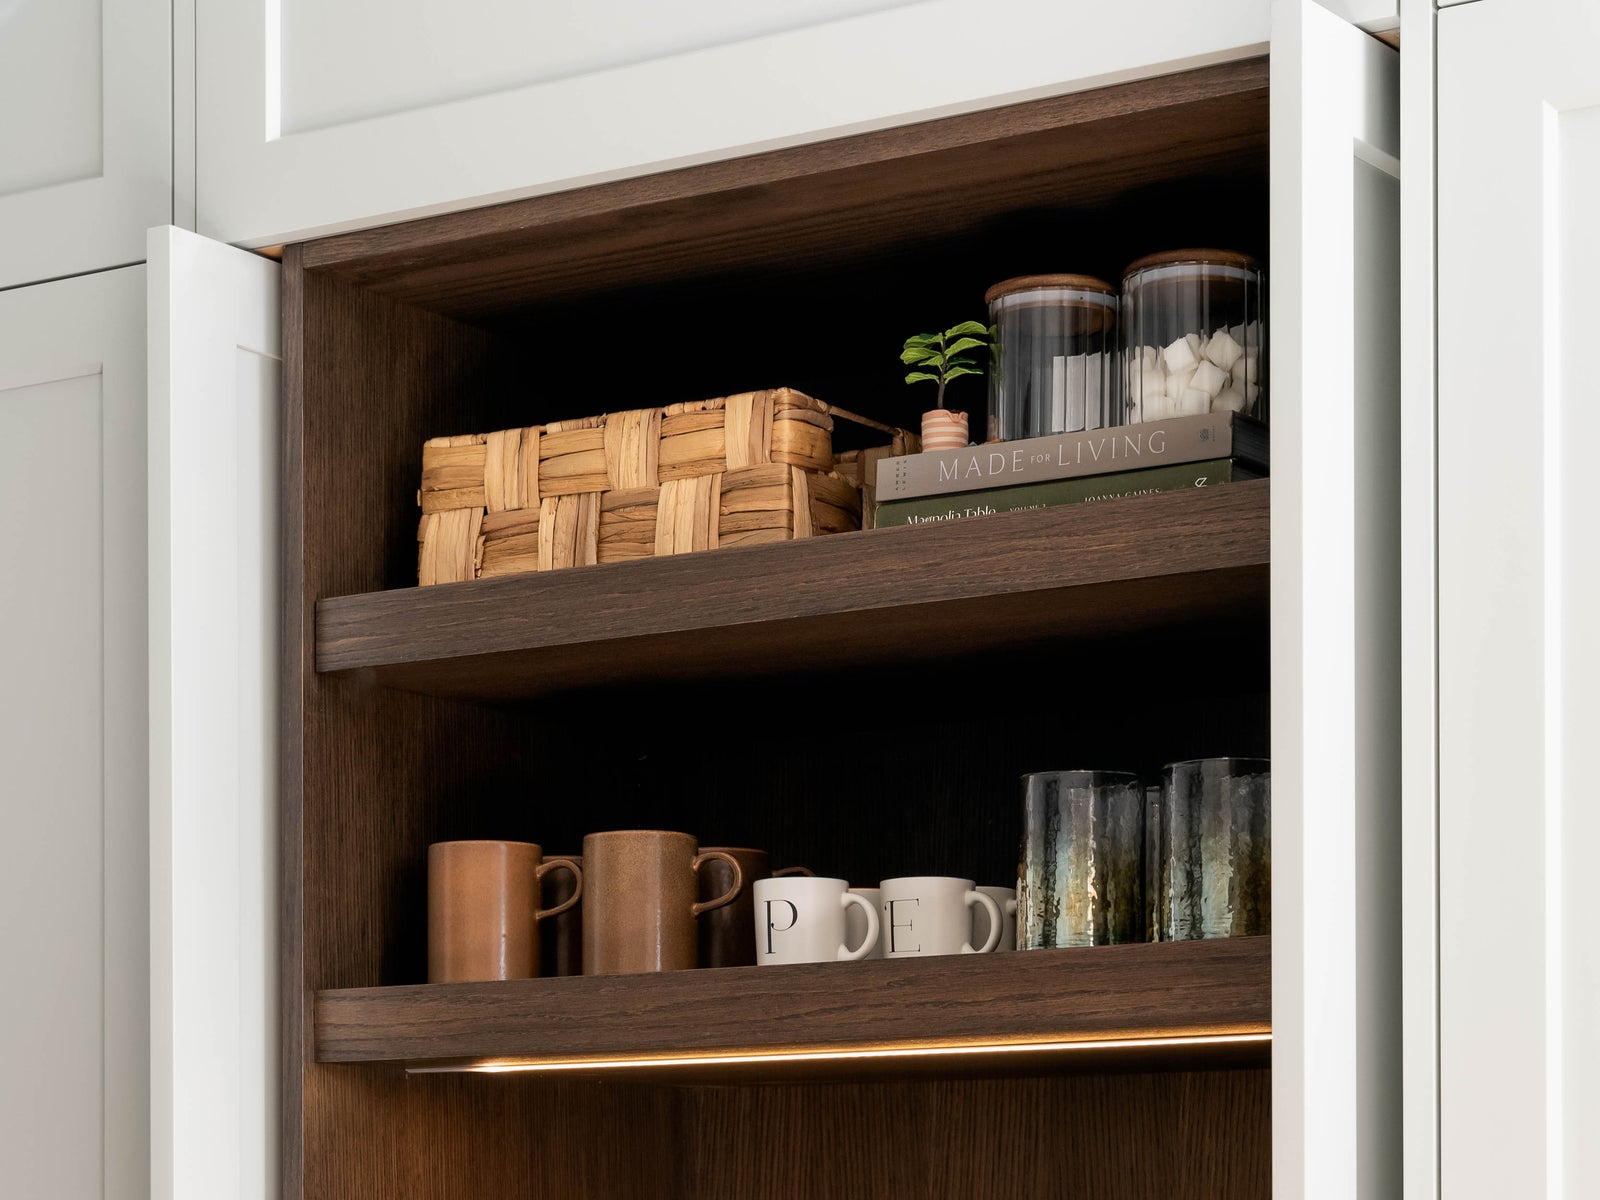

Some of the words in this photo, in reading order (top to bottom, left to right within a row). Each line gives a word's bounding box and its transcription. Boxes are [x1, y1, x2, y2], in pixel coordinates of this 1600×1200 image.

[939, 449, 1025, 482] MADE
[1030, 454, 1050, 464] FOR
[1058, 430, 1166, 466] LIVING
[763, 899, 798, 954] P
[884, 898, 921, 952] E
